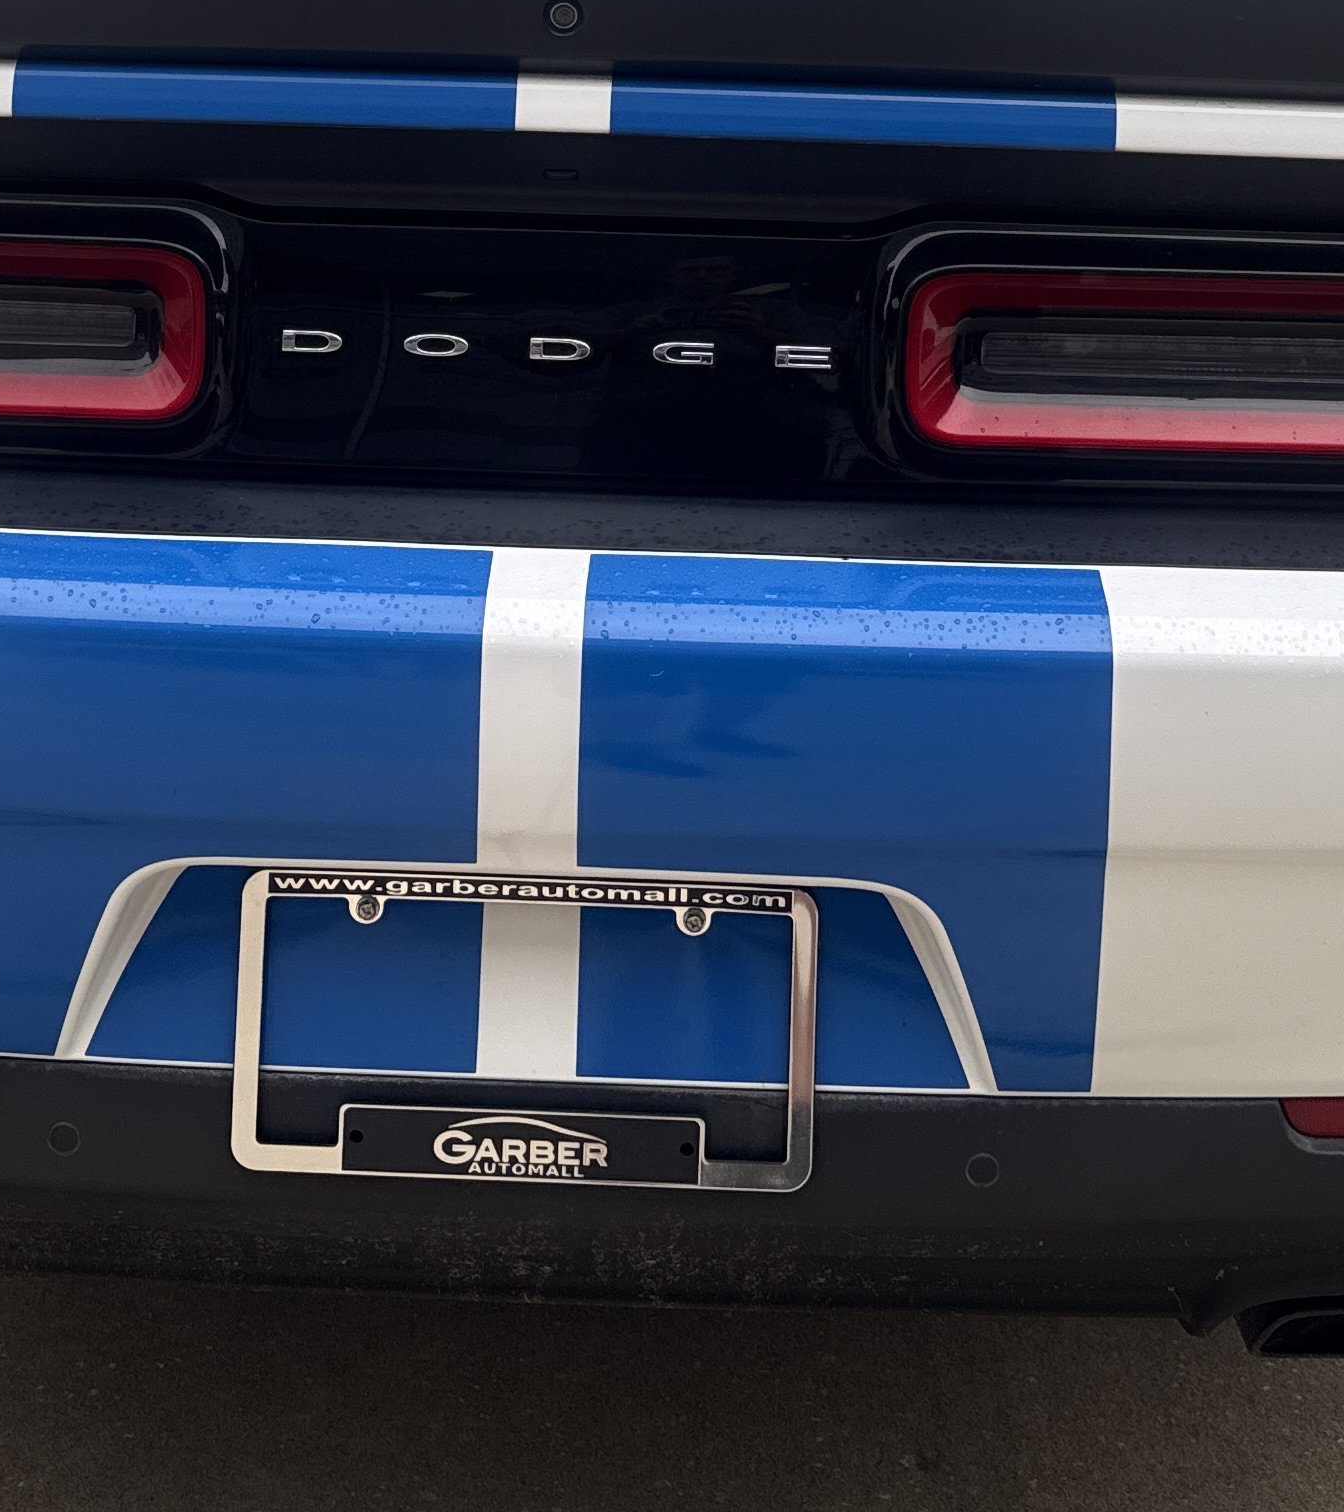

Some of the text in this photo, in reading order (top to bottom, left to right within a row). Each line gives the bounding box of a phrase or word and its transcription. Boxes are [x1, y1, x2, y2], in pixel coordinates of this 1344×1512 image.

[282, 329, 832, 369] DODGE
[273, 876, 787, 908] www.garberautomall.com
[433, 1128, 608, 1167] GARBER
[467, 1161, 585, 1178] AUTOMALL
